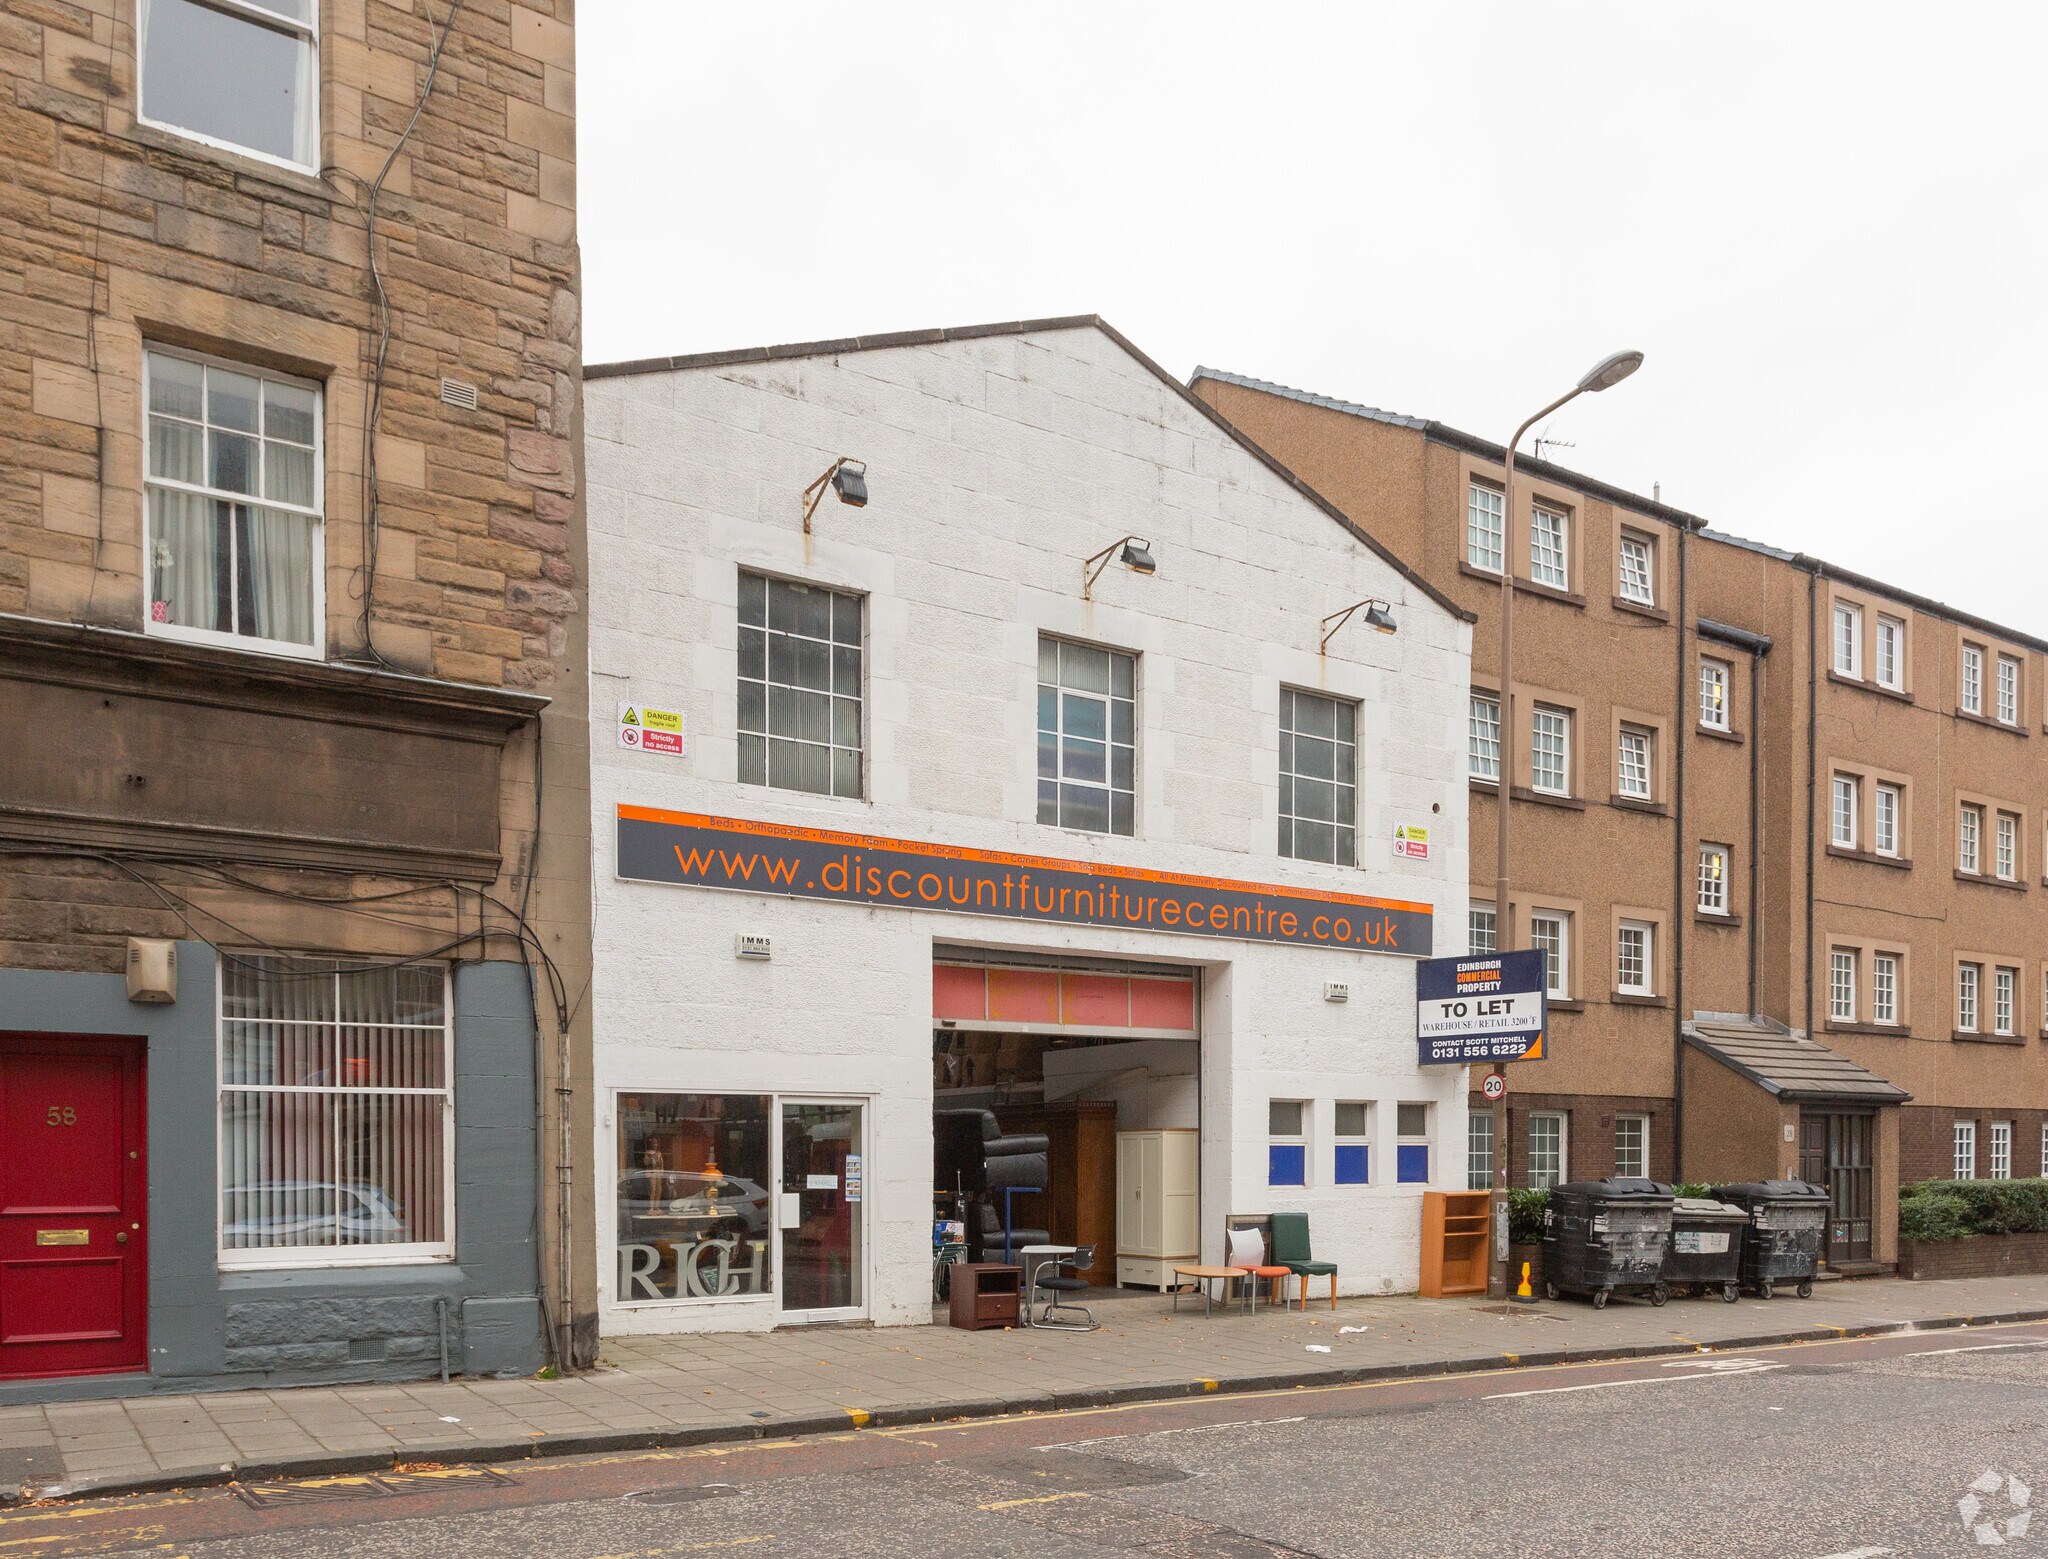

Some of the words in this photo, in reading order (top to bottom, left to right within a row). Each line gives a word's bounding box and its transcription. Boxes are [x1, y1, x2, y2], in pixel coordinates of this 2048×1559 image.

[647, 711, 678, 722] DANGER
[650, 733, 675, 744] Strictly
[656, 743, 680, 751] access
[709, 816, 735, 829] Beds
[745, 821, 809, 838] Orthopaedic
[819, 831, 859, 845] Memory
[862, 836, 888, 848] Foam
[897, 840, 929, 852] Pocket
[931, 845, 962, 857] Sprung
[980, 851, 1002, 861] Sofas
[1010, 854, 1039, 865] Corner
[1041, 858, 1071, 869] Groups
[1078, 862, 1096, 872] Sofa
[1098, 865, 1117, 875] Beds
[1124, 867, 1145, 877] Sofas
[1159, 872, 1169, 880] All
[1180, 875, 1215, 887] Massively
[674, 844, 1399, 948] www.discountfurniturecentre.co.uk
[741, 936, 771, 946] IMMS
[1457, 960, 1501, 972] EDINBURGH
[1457, 970, 1501, 983] COMMERCIAL
[1457, 981, 1501, 993] PROPERTY
[1441, 1002, 1468, 1018] TO
[1477, 998, 1515, 1016] LET
[1422, 1020, 1473, 1032] WAREHOUSE
[1479, 1018, 1510, 1029] RETAIL
[1511, 1017, 1528, 1027] 3200
[1432, 1039, 1464, 1048] CONTACT
[1466, 1037, 1489, 1046] SCOTT
[1490, 1035, 1527, 1043] MITCHELL
[1432, 1047, 1460, 1058] 0131
[1463, 1046, 1488, 1056] 556
[1492, 1044, 1527, 1055] 6222
[1485, 1081, 1502, 1092] 20
[46, 1105, 77, 1127] 58
[617, 1238, 770, 1300] RICH
